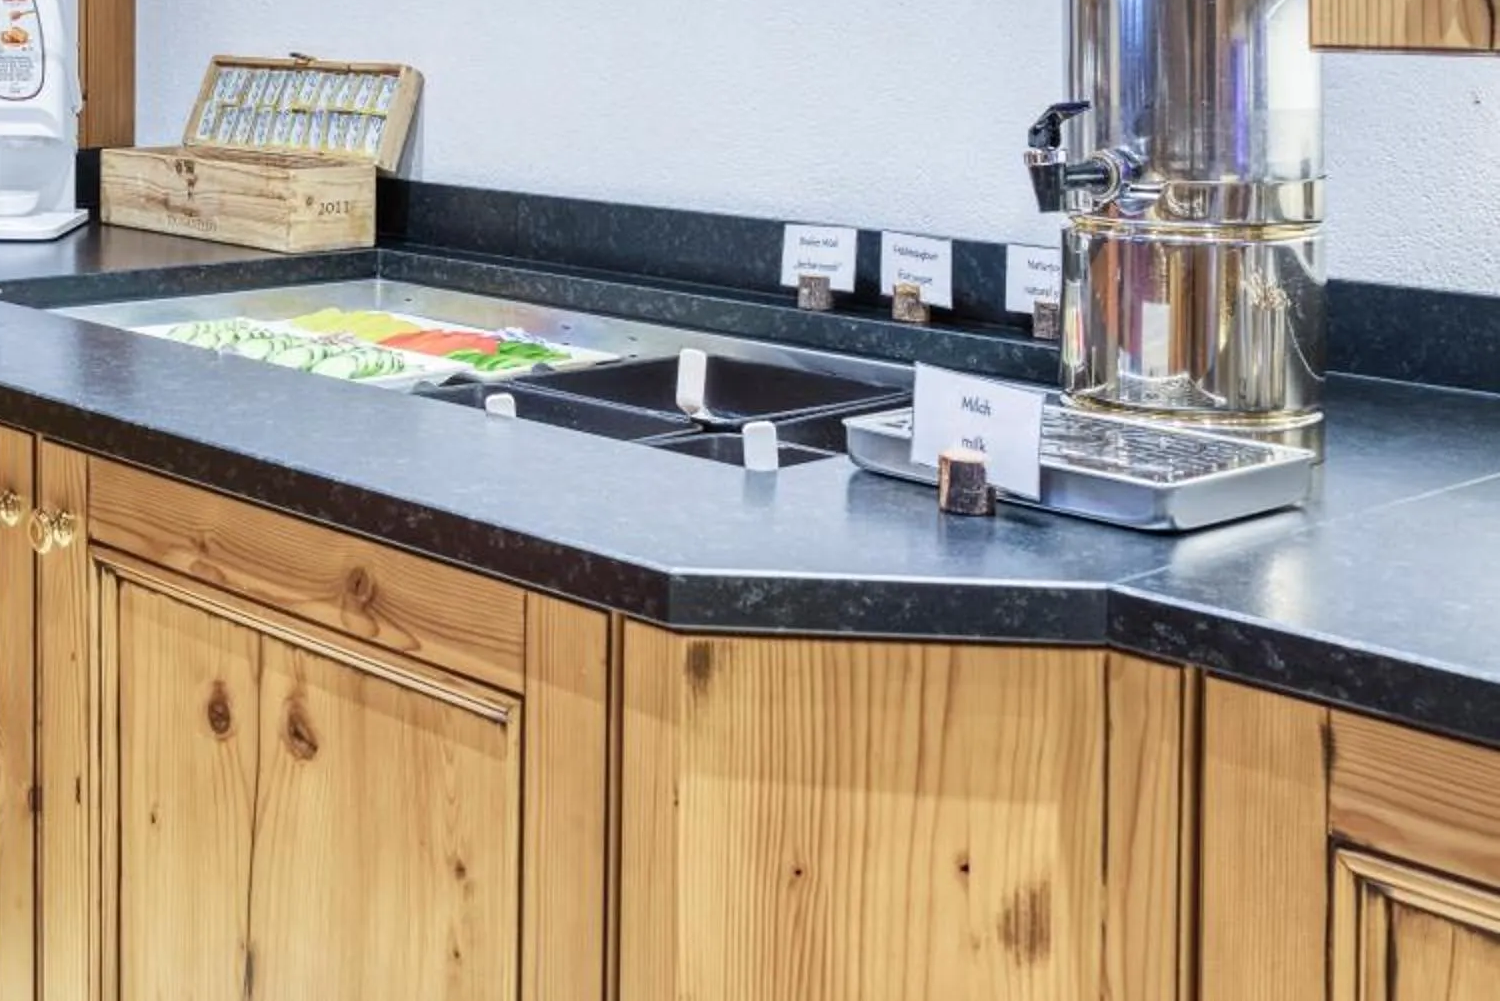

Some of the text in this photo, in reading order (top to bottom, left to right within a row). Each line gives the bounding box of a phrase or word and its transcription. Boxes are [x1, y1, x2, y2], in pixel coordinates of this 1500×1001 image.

[318, 200, 349, 216] 2011
[962, 396, 991, 417] Milch
[961, 437, 986, 453] milk
